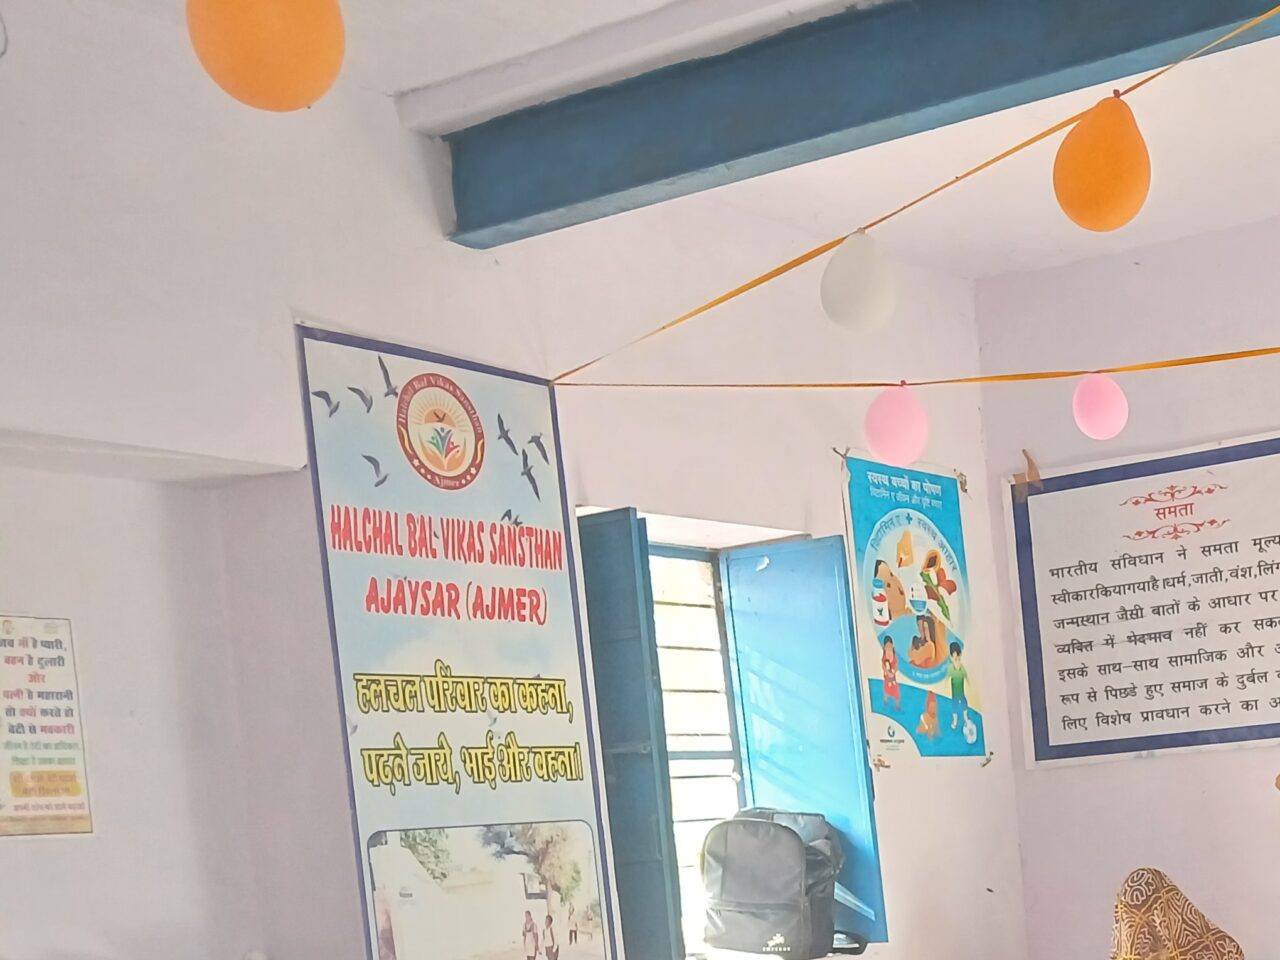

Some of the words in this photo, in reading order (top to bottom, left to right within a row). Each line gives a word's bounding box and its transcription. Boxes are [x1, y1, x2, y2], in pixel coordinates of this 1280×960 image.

[911, 480, 920, 492] का
[1155, 502, 1194, 521] समता
[330, 504, 404, 557] HALCHAL
[406, 513, 438, 559] BAL
[440, 517, 485, 564] VIKAS
[489, 522, 563, 572] SANSTHAN
[1049, 560, 1098, 579] भारतीय
[1110, 552, 1164, 570] संविधान
[1176, 544, 1186, 560] ने
[1200, 540, 1239, 557] समता
[365, 577, 461, 620] AJAYSAR
[466, 581, 547, 626] (AJMER)
[1053, 612, 1110, 629] जन्मस्थान
[1116, 604, 1144, 620] जैसी
[1150, 599, 1180, 616] बातों
[1187, 596, 1200, 612] के
[1208, 593, 1252, 608] आधार
[1258, 590, 1278, 602] पर
[1055, 638, 1093, 654] व्यक्ति
[1126, 630, 1172, 646] भेदभाव
[1184, 622, 1208, 638] नहीं
[1218, 622, 1242, 634] कर
[1058, 662, 1088, 682] इसके
[1166, 648, 1227, 667] सामाजिक
[1237, 642, 1264, 658] और
[354, 672, 424, 713] हलचल
[422, 659, 487, 713] परिवार
[487, 677, 517, 713] का
[516, 677, 573, 723] कहना,
[1060, 693, 1080, 705] रूप
[1104, 682, 1138, 700] पिछडे
[1144, 684, 1164, 700] हुए
[1170, 678, 1208, 693] समाज
[1236, 668, 1269, 690] दुर्बल
[1061, 715, 1087, 730] लिए
[1096, 710, 1132, 726] विशेष
[1140, 706, 1190, 722] प्रावधान
[1199, 698, 1231, 716] करने
[1240, 699, 1259, 712] का
[410, 731, 461, 794] जाये,
[461, 730, 498, 790] भाई
[498, 731, 532, 783] और
